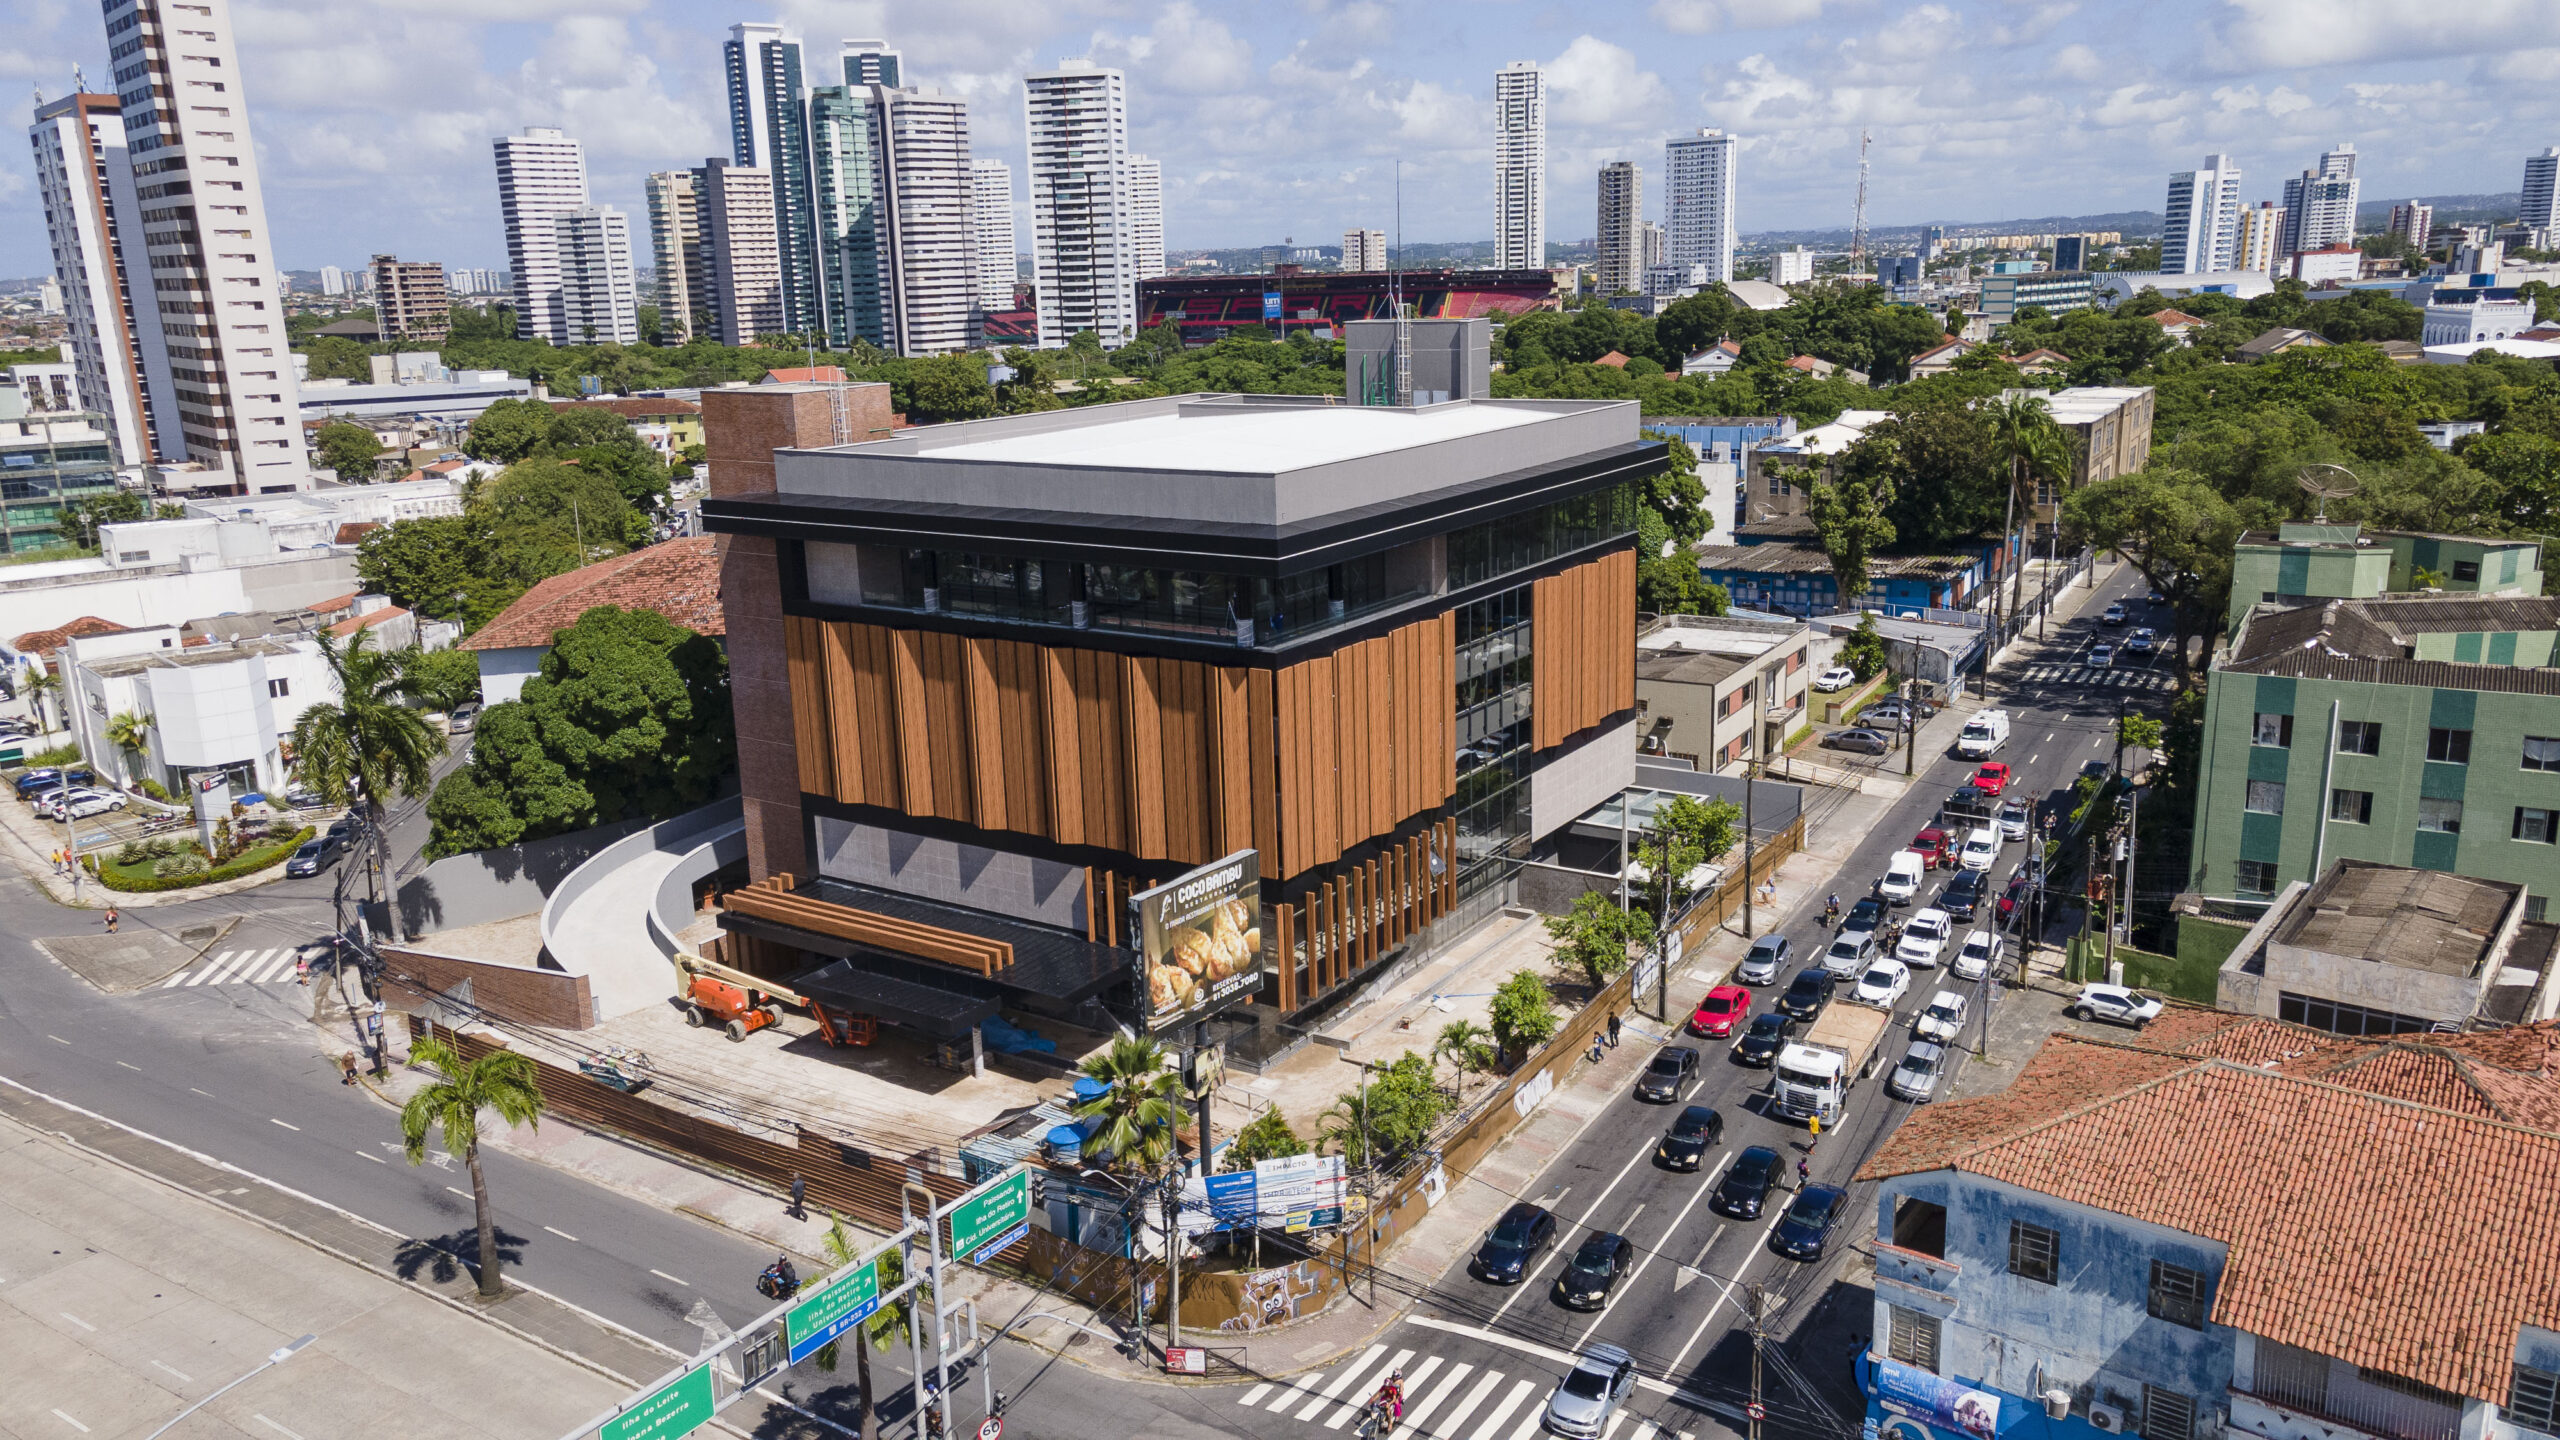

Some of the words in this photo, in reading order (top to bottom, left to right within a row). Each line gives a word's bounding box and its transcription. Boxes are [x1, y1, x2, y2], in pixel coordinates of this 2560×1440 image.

[1178, 879, 1205, 903] COCO
[1206, 863, 1242, 892] BAMBU
[1185, 883, 1237, 909] RESTAURANTE
[1212, 972, 1242, 991] RESERVAS:
[1272, 1161, 1307, 1171] IMPACTO
[976, 1214, 987, 1225] Ilha
[988, 1209, 996, 1218] do
[997, 1199, 1015, 1213] Retiro
[966, 1233, 977, 1245] Cid.
[978, 1211, 1015, 1237] Universitária
[795, 1327, 810, 1340] Cid.
[812, 1294, 861, 1329] Universitária
[808, 1308, 824, 1322] Ilha
[826, 1301, 836, 1311] do
[837, 1286, 860, 1303] Retiro
[840, 1310, 863, 1329] BR-232
[622, 1415, 640, 1430] Ilha
[643, 1406, 655, 1417] do
[656, 1390, 679, 1409] Leite
[655, 1401, 689, 1427] Bezerra
[983, 1421, 1000, 1436] 60
